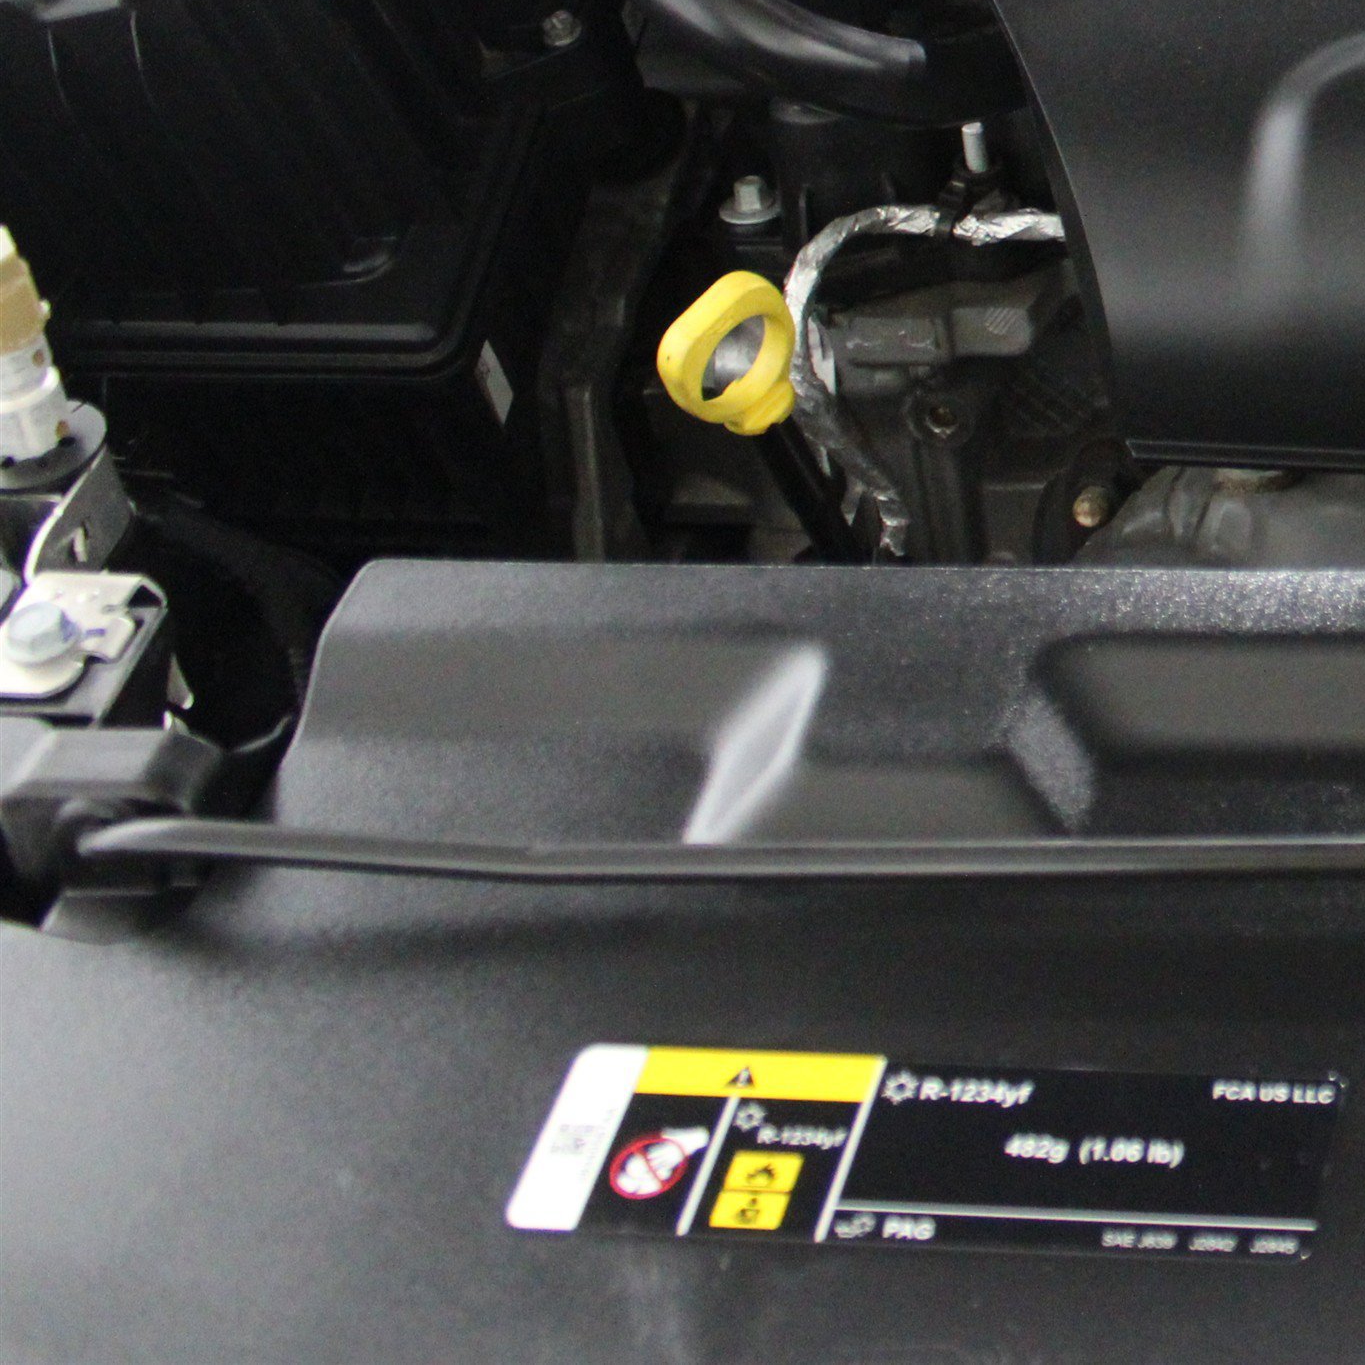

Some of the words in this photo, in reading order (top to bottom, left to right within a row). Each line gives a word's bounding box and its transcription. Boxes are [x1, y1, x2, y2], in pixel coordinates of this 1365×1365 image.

[919, 1076, 1035, 1108] R-1234yf
[1212, 1079, 1257, 1101] FCA
[1259, 1081, 1290, 1103] US
[1292, 1083, 1336, 1105] LLC
[1148, 1138, 1185, 1169] lb)
[882, 1216, 936, 1240] PAG
